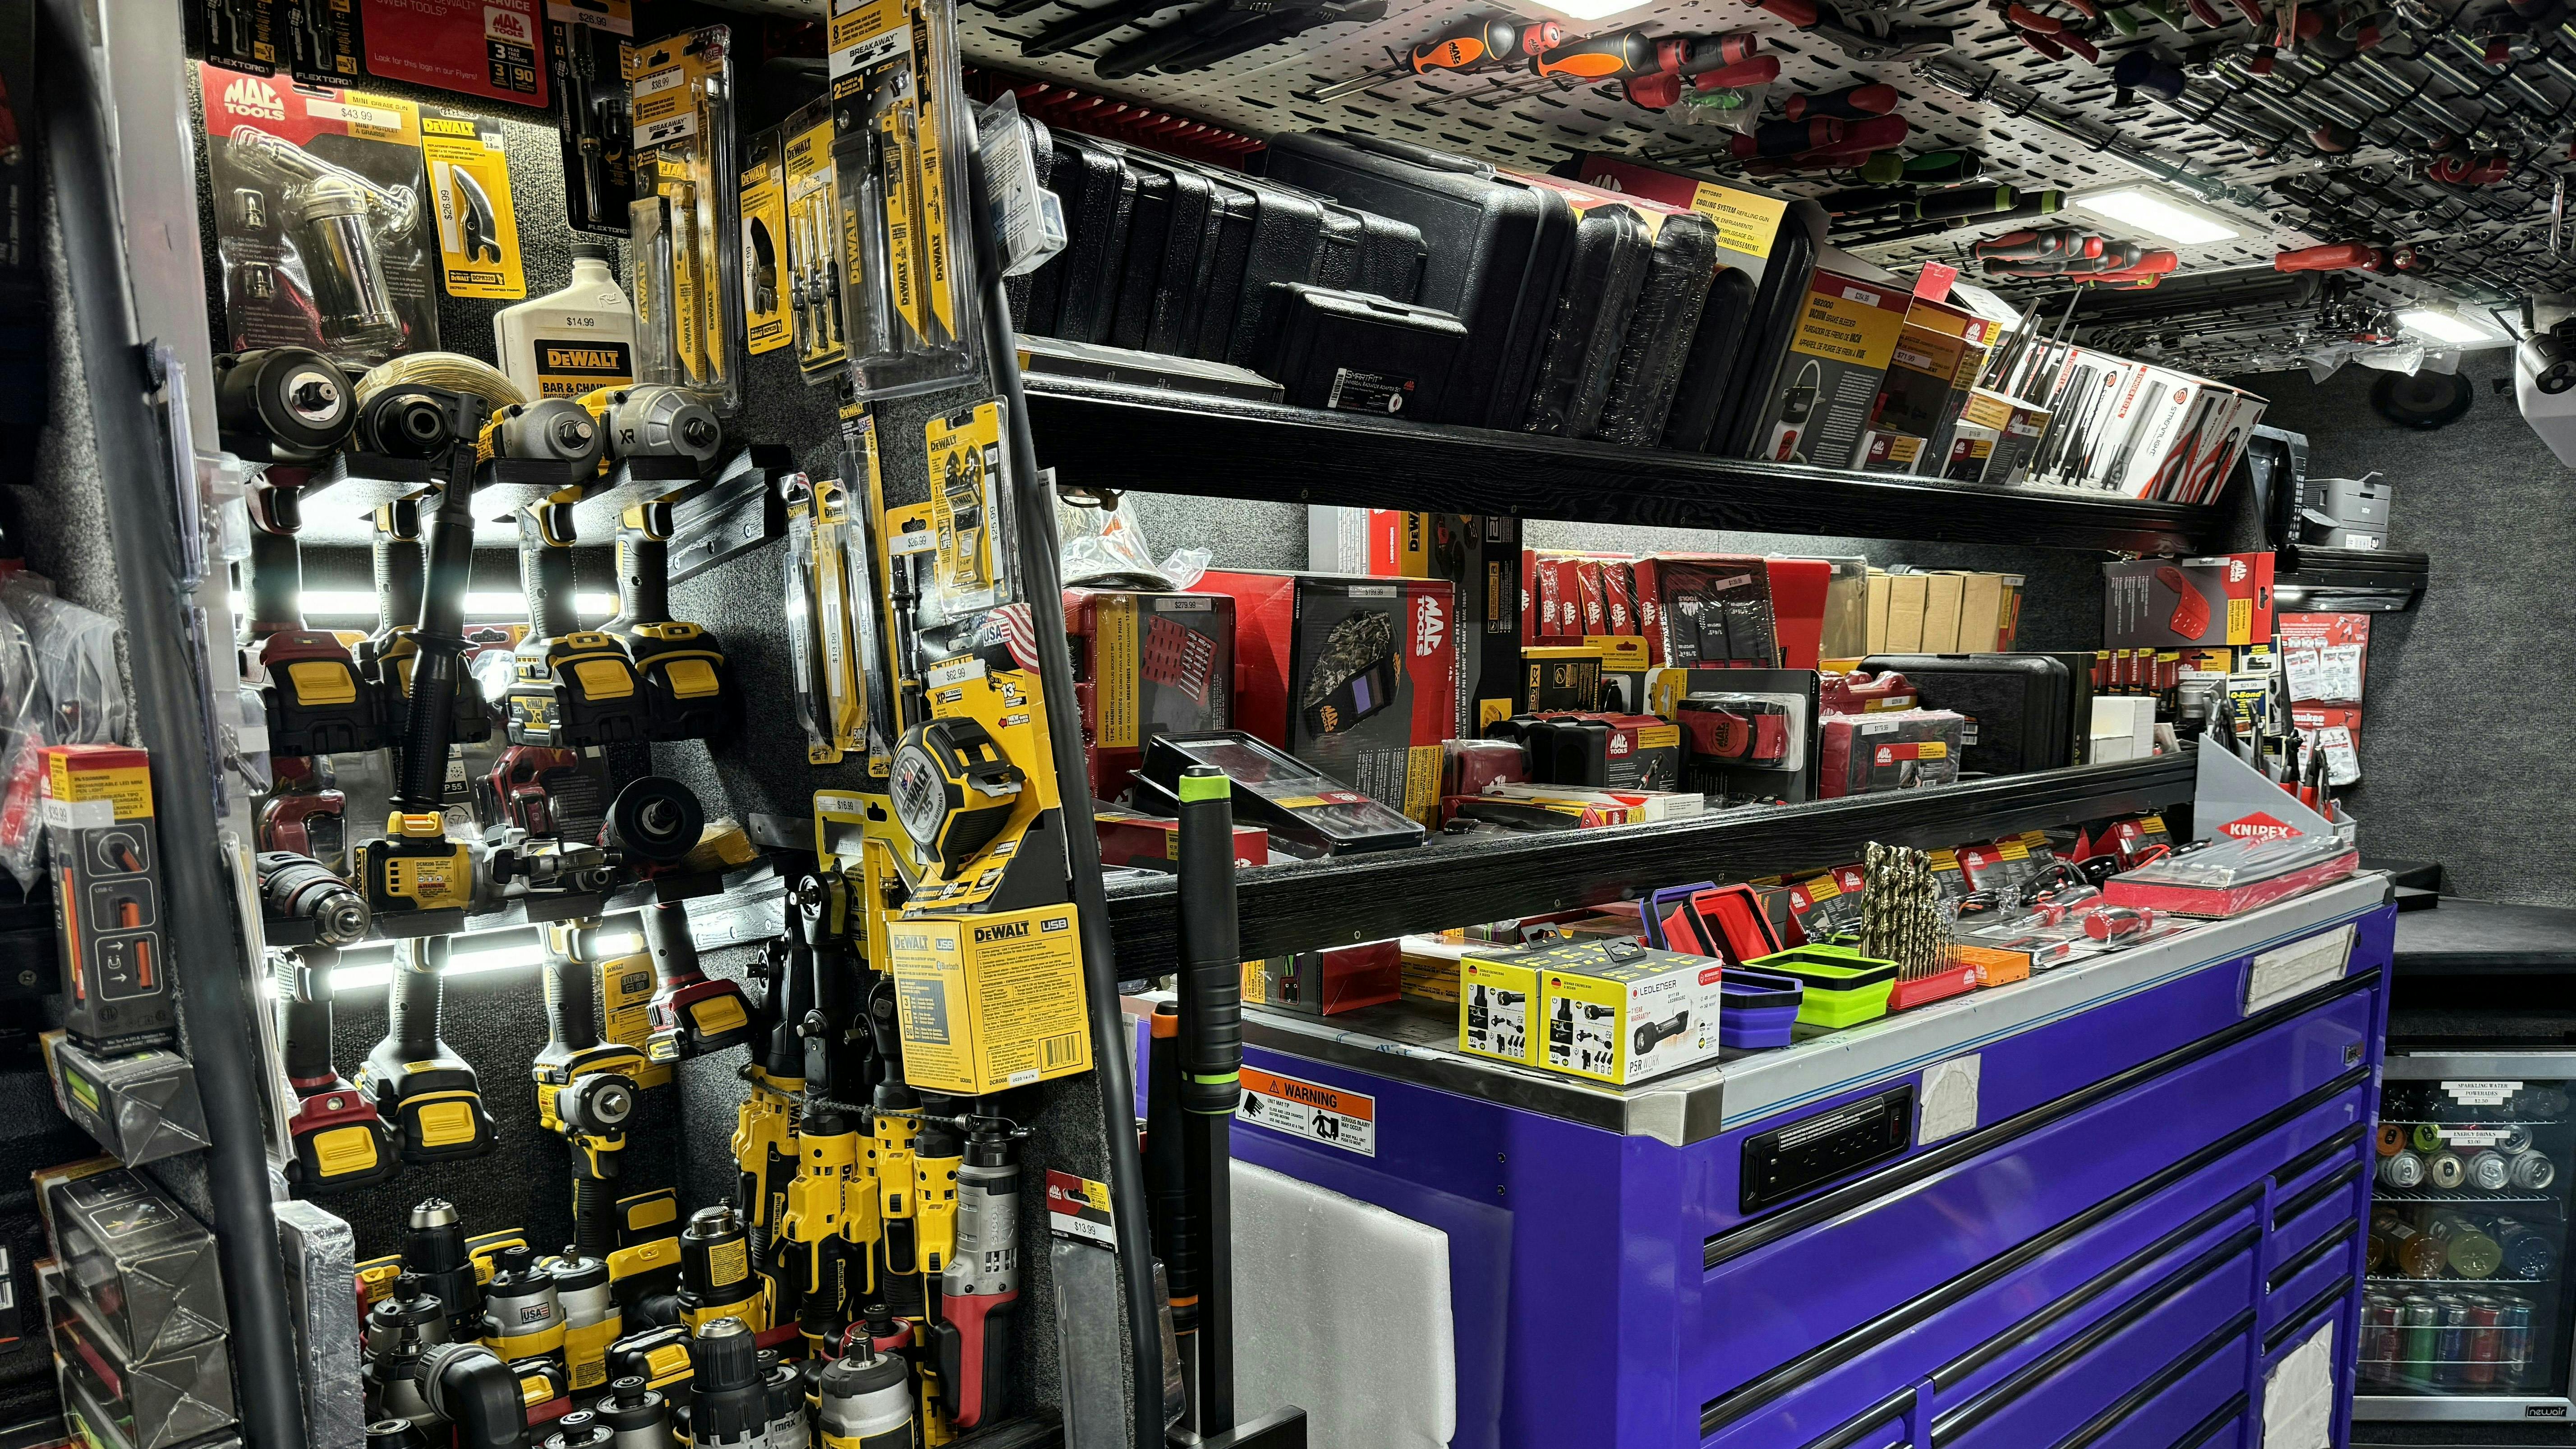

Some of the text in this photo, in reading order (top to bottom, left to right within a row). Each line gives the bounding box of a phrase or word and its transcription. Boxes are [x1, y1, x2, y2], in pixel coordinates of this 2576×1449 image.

[411, 1, 447, 16] TOOLS?
[492, 14, 524, 32] MAC
[579, 13, 607, 27] $26.99
[492, 27, 524, 38] TOOLS
[833, 25, 839, 40] 8
[495, 44, 506, 59] 3
[850, 33, 895, 57] BREAKAWAY
[374, 52, 390, 62] Look
[391, 56, 401, 65] for
[404, 58, 418, 68] this
[419, 61, 433, 72] logo
[435, 64, 442, 72] in
[495, 64, 504, 77] 3
[514, 68, 534, 83] 90
[651, 77, 669, 90] $38.99
[858, 74, 864, 90] 1
[224, 78, 284, 111] MAC
[833, 83, 842, 100] 2
[353, 96, 368, 105] MINI
[225, 103, 285, 121] TOOLS
[341, 108, 373, 121] $43.99
[635, 102, 643, 116] 10
[649, 118, 685, 133] BREAKAWAY
[637, 152, 643, 167] 2
[441, 189, 452, 220] $26.99
[1696, 198, 1716, 209] COOLING
[1717, 204, 1736, 214] SYSTEM
[1736, 210, 1758, 220] REFILLING
[1720, 218, 1753, 230] ENFRIAMIENTO
[844, 207, 861, 285] DEWALT
[1813, 298, 1834, 309] BB2000
[566, 317, 594, 327] $14.99
[1808, 308, 1856, 327] VACUUM BRAKE BLEEDER
[1804, 324, 1826, 336] PURGADOR
[1825, 329, 1831, 337] DE
[1830, 331, 1843, 340] FRENO
[1799, 339, 1853, 357] APPAREIL DE PURGE DE FREIN
[1897, 351, 1915, 362] $71.99
[542, 382, 574, 393] BAR &
[2149, 406, 2177, 456] STREAMLIGHT
[930, 435, 957, 452] DEWALT
[990, 506, 998, 542] $25.99
[907, 536, 927, 547] $26.99
[1416, 595, 1425, 657] TOOLS
[1423, 595, 1444, 657] MAC
[983, 625, 1003, 643] USA
[947, 667, 966, 681] $62.99
[1531, 665, 1540, 686] XR
[1001, 682, 1016, 698] 13'
[935, 692, 945, 704] XP
[532, 709, 543, 723] XR
[1320, 707, 1329, 732] TOOLS
[1324, 705, 1339, 731] MAC
[1610, 733, 1628, 749] MAC
[1877, 747, 1891, 759] MAC
[451, 782, 462, 791] 55
[902, 764, 930, 820] DEWALT
[837, 800, 854, 810] $16.99
[1845, 871, 1863, 883] MAC
[943, 882, 959, 895] 60
[975, 919, 1067, 943] DEWALT USB
[894, 936, 954, 949] DEWALT USB
[941, 961, 959, 971] Bluetooth
[1640, 980, 1677, 996] LEDLENSER
[904, 998, 909, 1007] 3
[906, 1027, 913, 1036] 90
[1629, 1054, 1660, 1073] P5R WORK
[989, 1077, 1008, 1086] DCR008
[1284, 1082, 1338, 1109] WARNING
[1341, 1116, 1370, 1128] SERIOUS INJURY
[1349, 1124, 1362, 1132] OCCUR
[1049, 1185, 1061, 1195] MAC
[1074, 1221, 1096, 1235] $13.99
[523, 1308, 542, 1320] USA
[2529, 1408, 2566, 1417] newair
[775, 1417, 796, 1432] MAX
